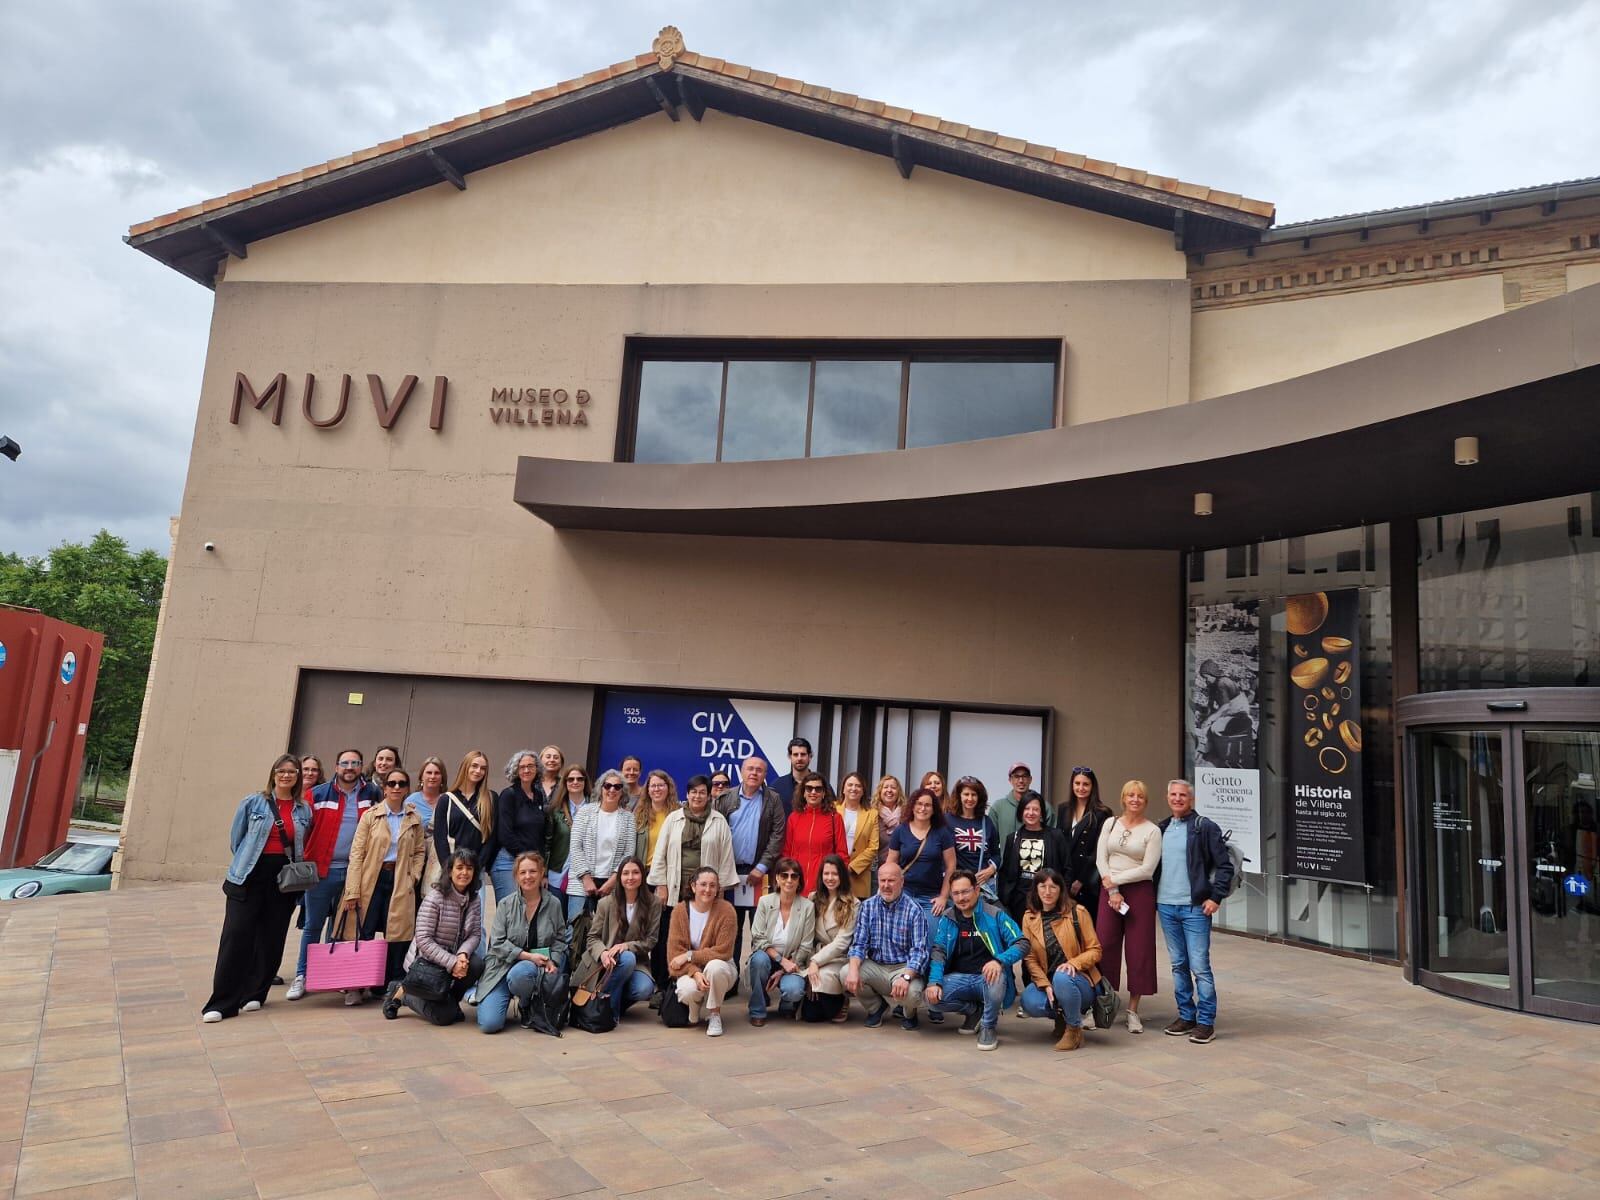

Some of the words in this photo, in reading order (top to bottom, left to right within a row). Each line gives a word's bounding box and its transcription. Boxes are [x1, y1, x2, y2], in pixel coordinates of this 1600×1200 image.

[230, 371, 448, 430] MUVI
[491, 387, 568, 404] MUSEO
[489, 407, 588, 426] VILLENA
[623, 707, 640, 715] 1525
[626, 716, 647, 724] 2025
[691, 711, 734, 733] CIV
[701, 736, 755, 760] DAD
[1201, 772, 1242, 787] Ciento
[1294, 784, 1352, 800] Historia
[1295, 798, 1308, 807] de
[1310, 799, 1342, 810] Villena
[1319, 810, 1335, 818] siglo
